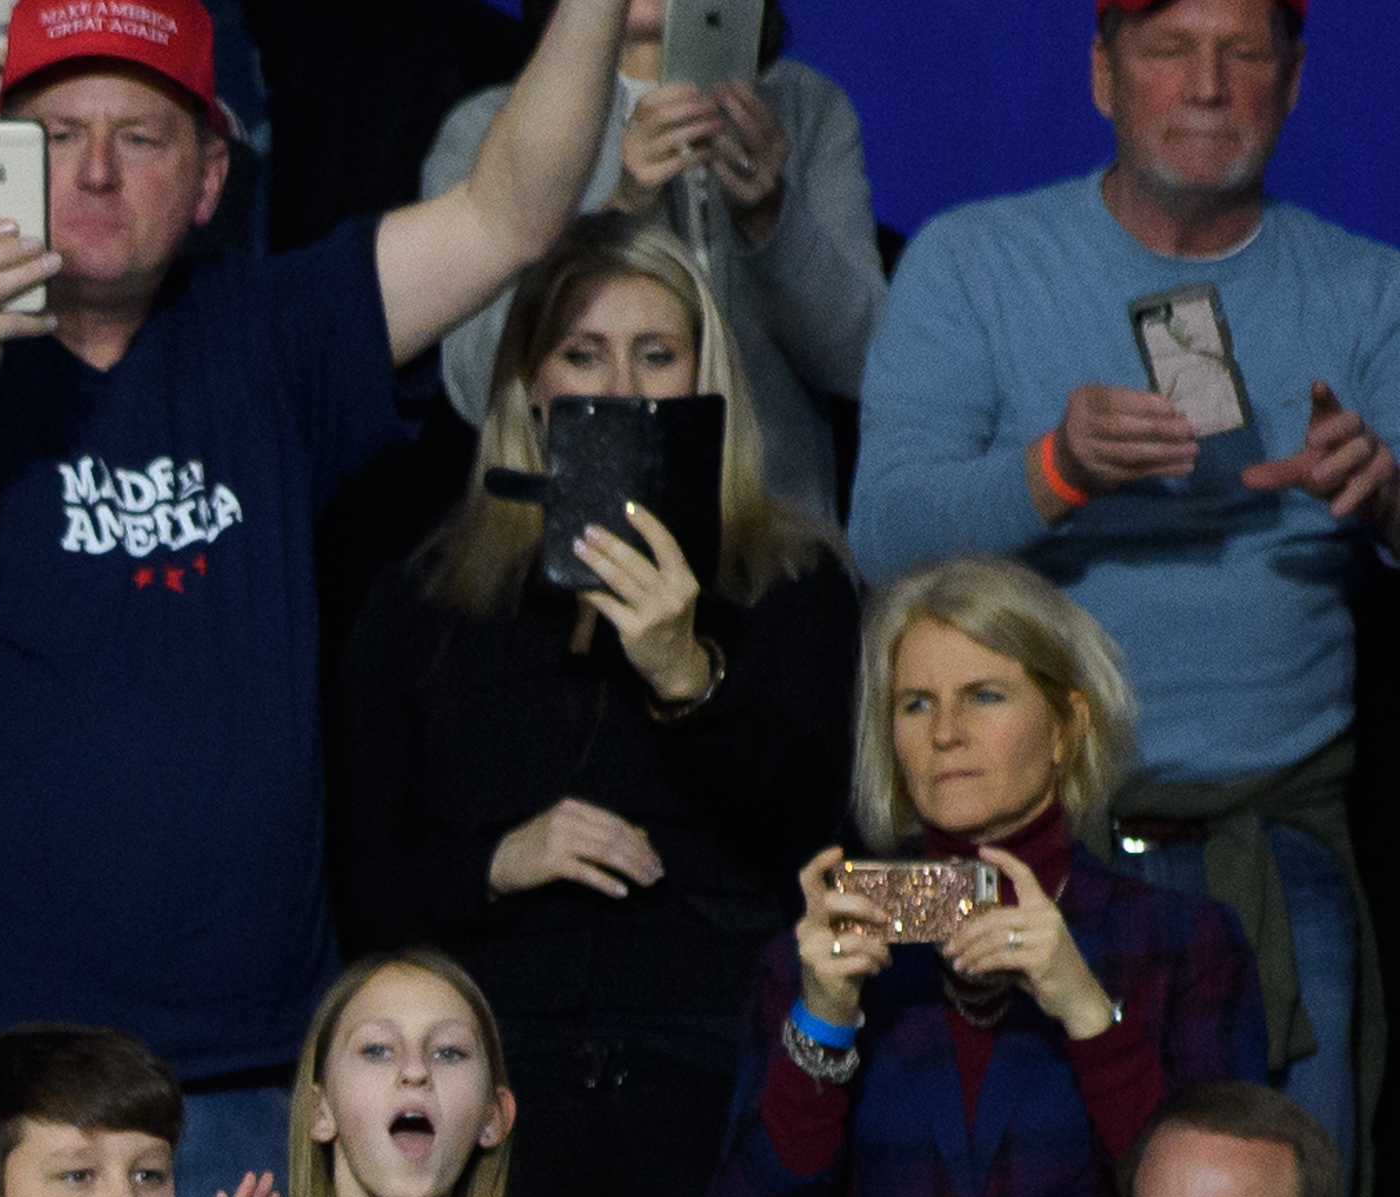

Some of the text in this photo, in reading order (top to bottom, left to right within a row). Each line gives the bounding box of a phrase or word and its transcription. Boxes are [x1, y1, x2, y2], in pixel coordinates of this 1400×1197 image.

[39, 1, 178, 34] MAKE AMERICA
[46, 17, 170, 46] GREAT AGAIN
